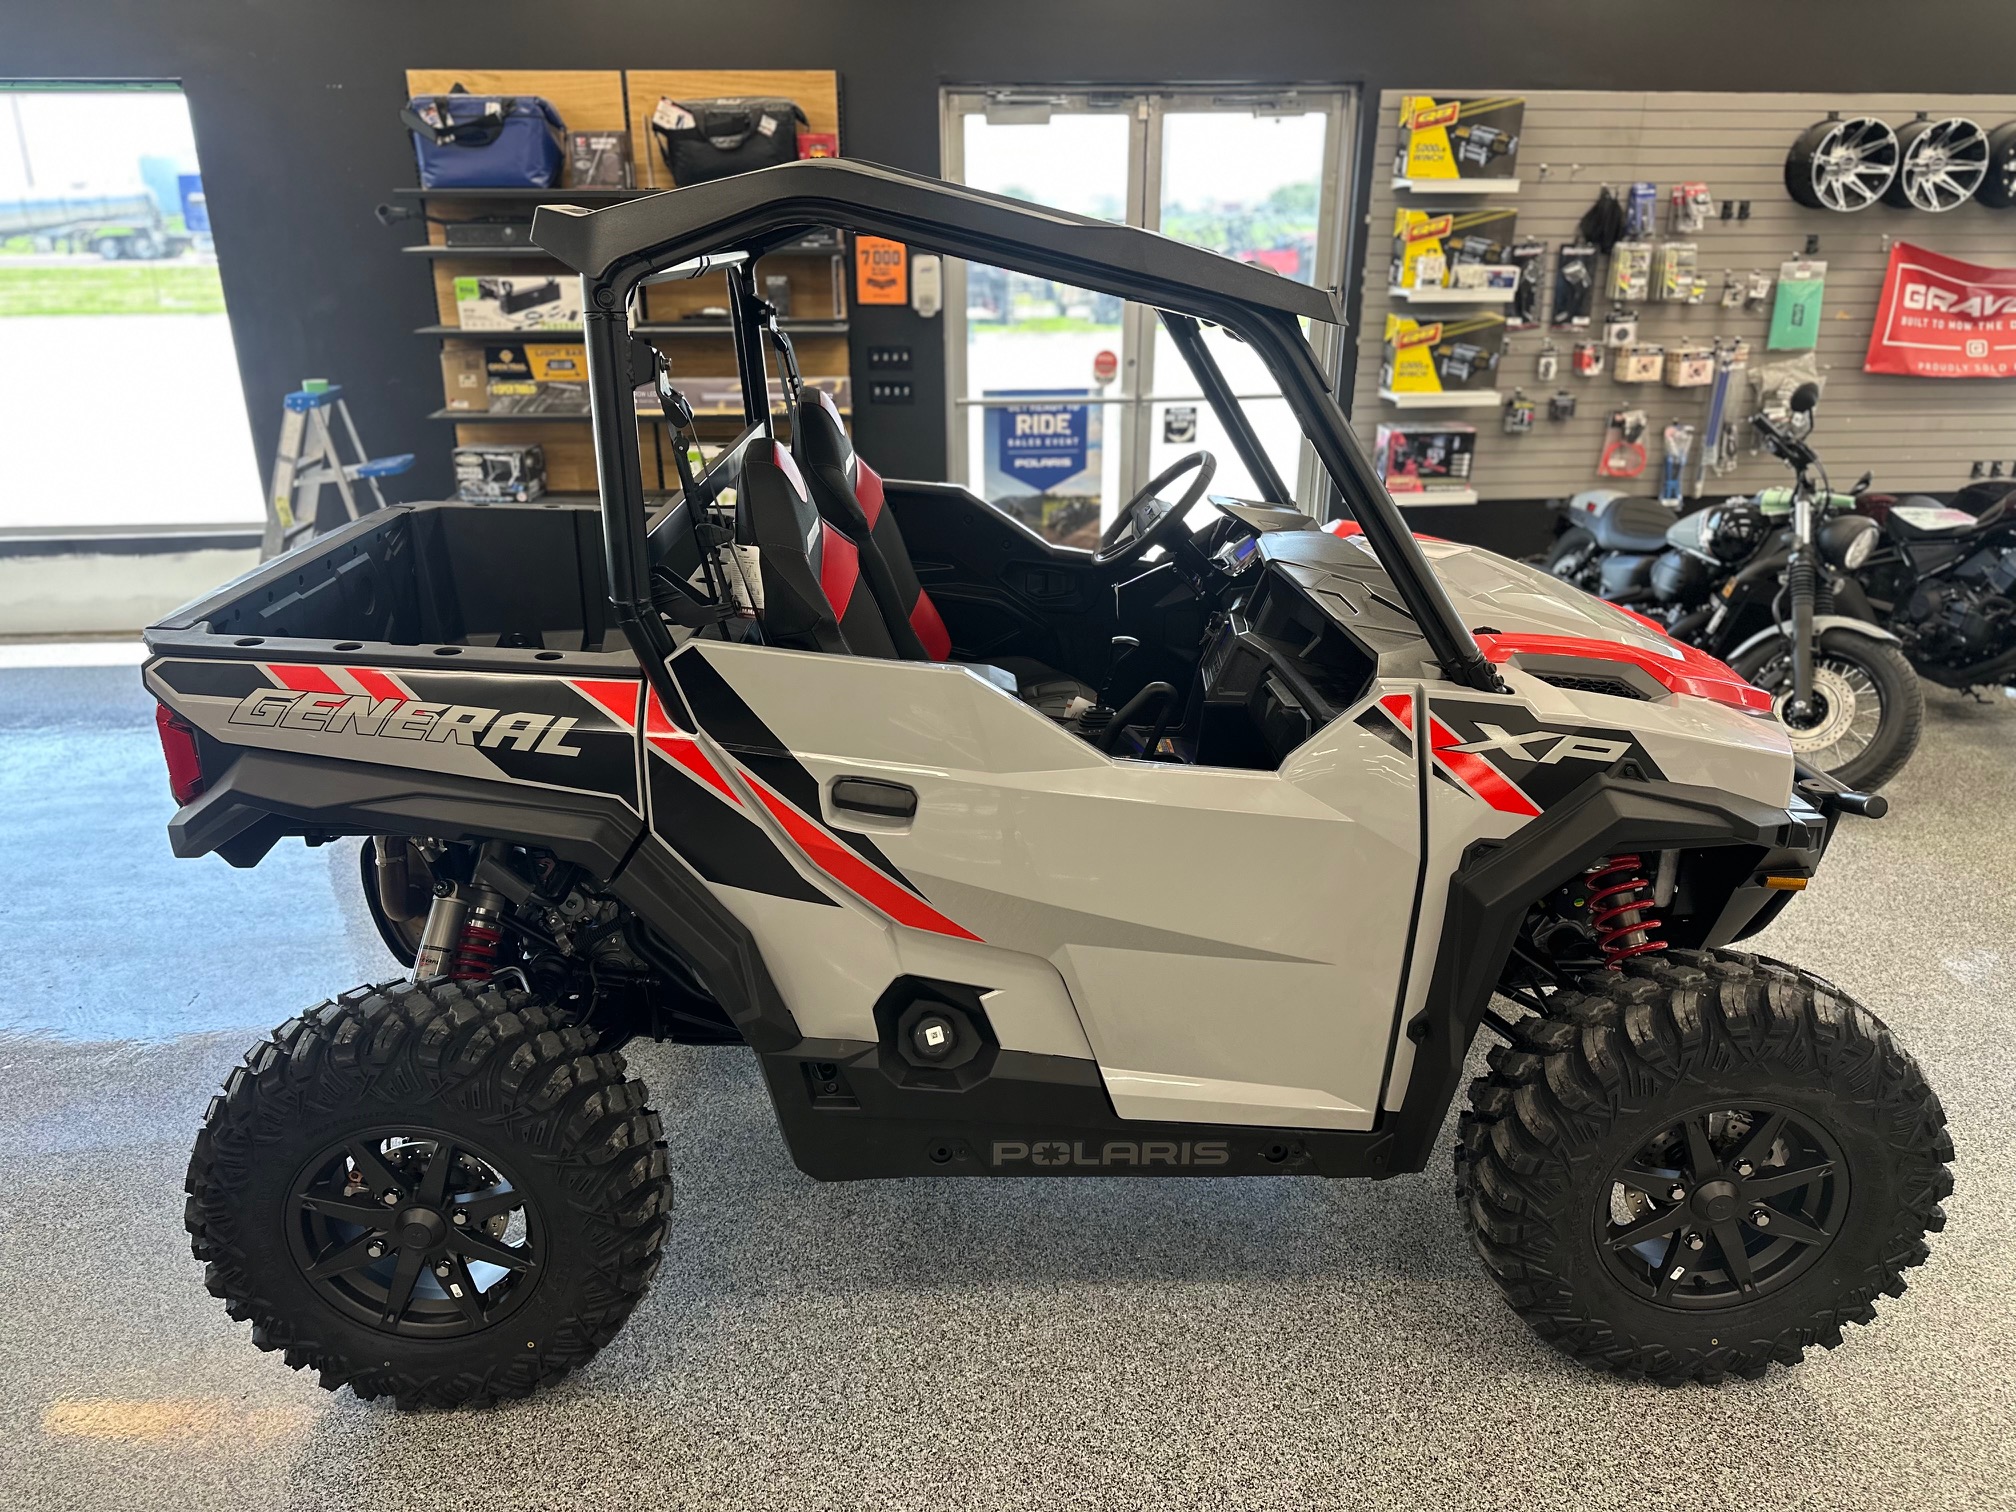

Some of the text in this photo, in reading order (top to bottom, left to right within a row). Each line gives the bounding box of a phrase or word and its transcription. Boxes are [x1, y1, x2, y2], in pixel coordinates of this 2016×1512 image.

[1901, 315, 1928, 328] BUILT
[1932, 319, 1945, 329] TO
[1978, 320, 2003, 331] THE
[1918, 361, 2007, 374] PROUDLY SOLD
[1015, 412, 1072, 436] RIDE
[1007, 436, 1079, 447] SALES EVENT
[1013, 457, 1072, 468] POLARIS
[228, 687, 582, 758] GENERAL
[1441, 720, 1633, 765] XP
[992, 1140, 1231, 1166] POLARIS
